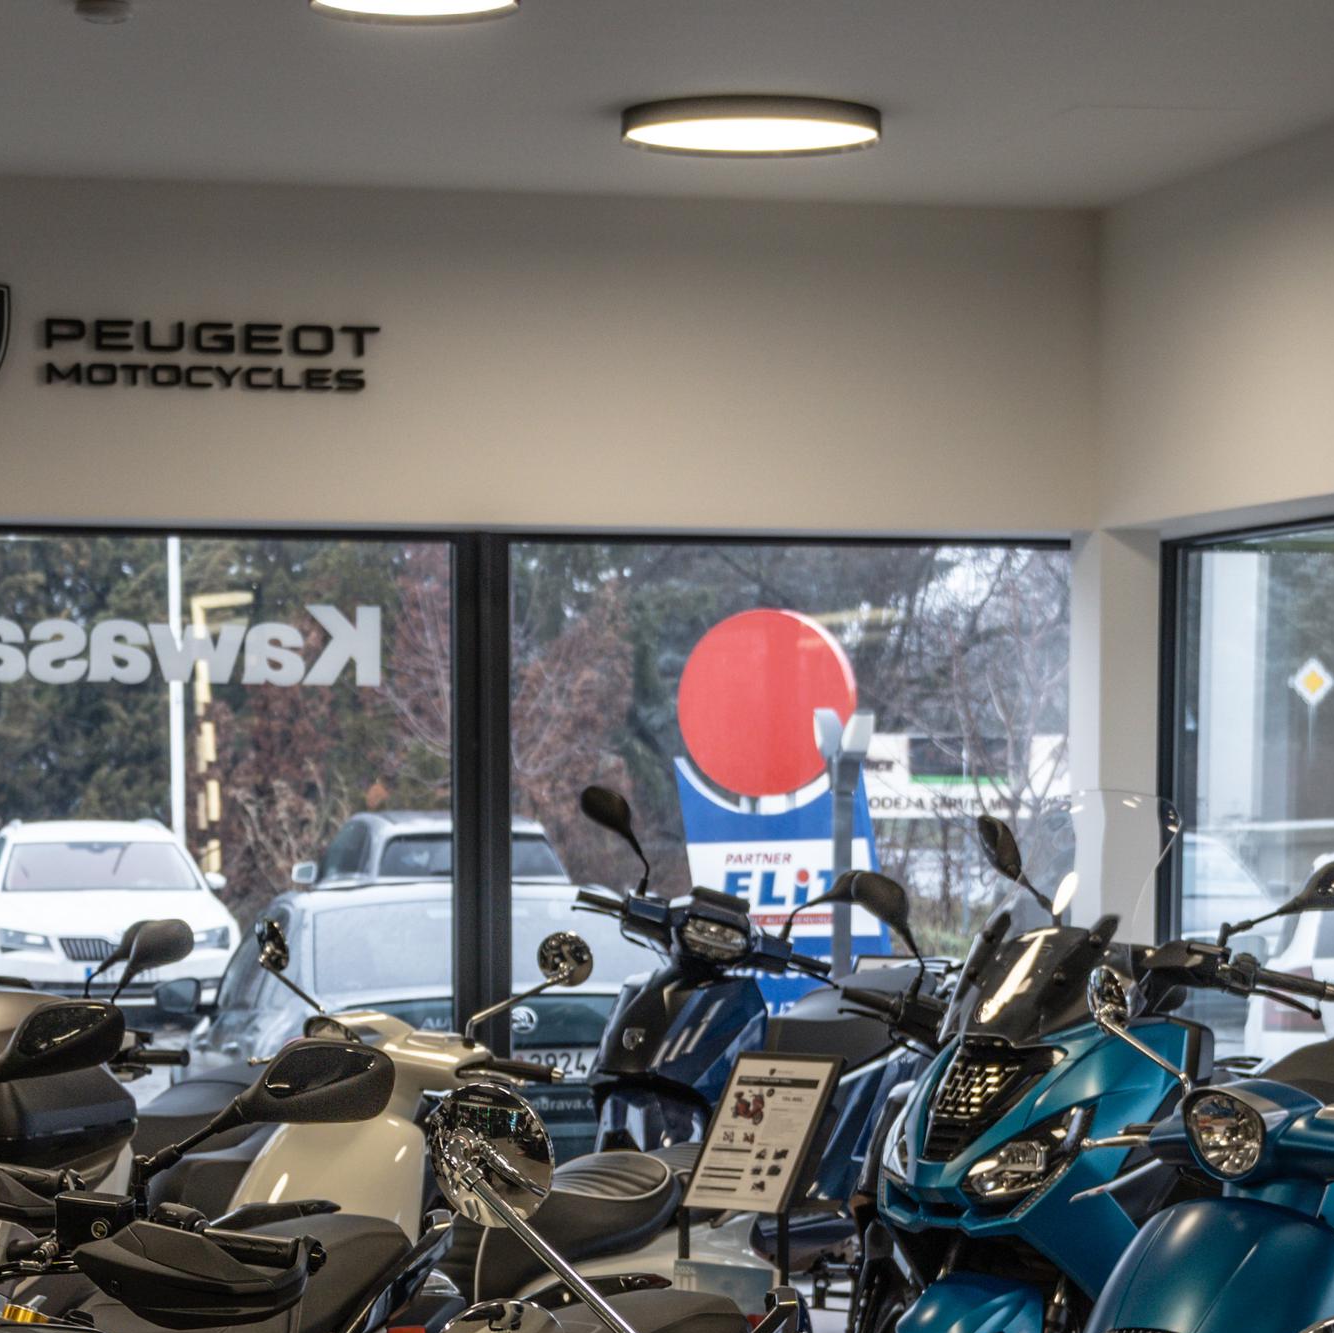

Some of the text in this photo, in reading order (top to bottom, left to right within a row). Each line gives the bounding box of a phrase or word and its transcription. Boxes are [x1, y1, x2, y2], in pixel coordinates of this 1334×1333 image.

[44, 317, 381, 358] PEUGEOT
[44, 362, 366, 394] MOTOCYCLES
[725, 853, 792, 865] PARTNER
